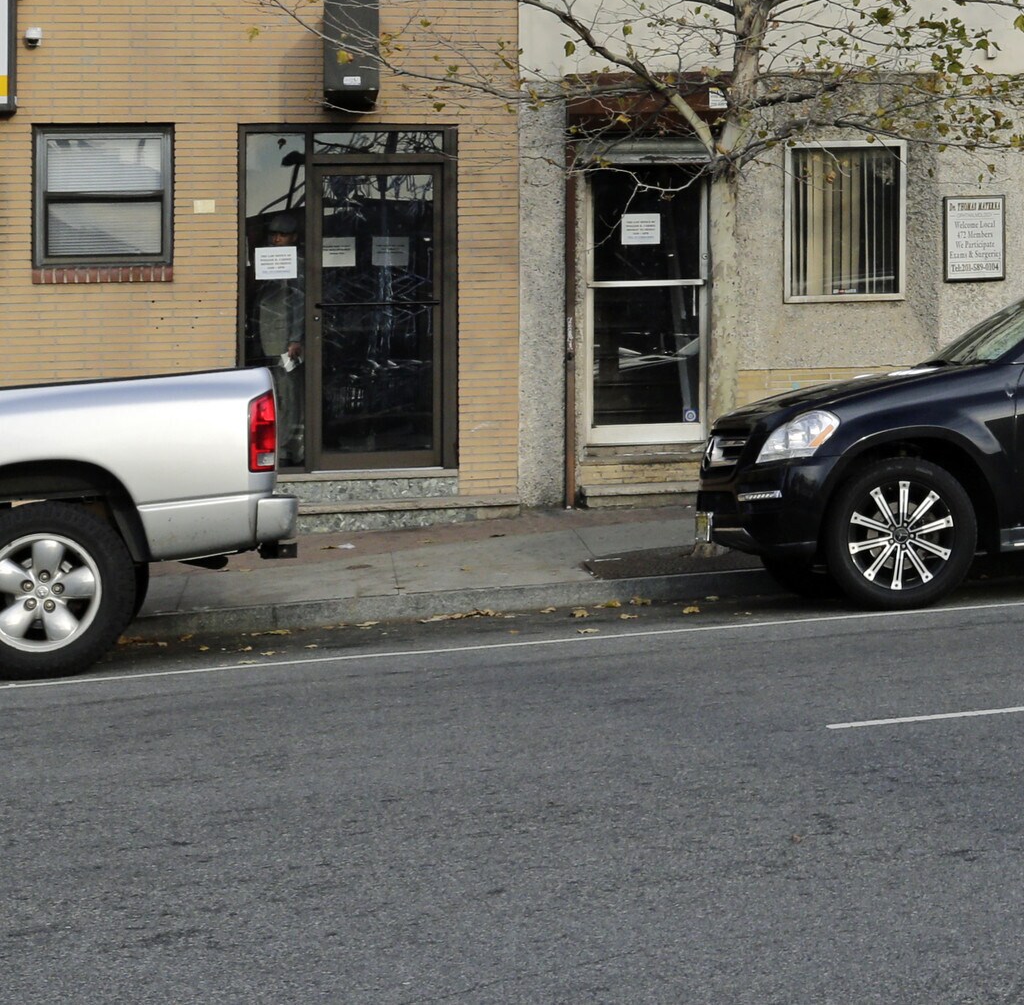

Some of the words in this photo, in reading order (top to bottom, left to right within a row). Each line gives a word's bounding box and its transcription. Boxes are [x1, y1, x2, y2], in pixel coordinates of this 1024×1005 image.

[957, 202, 977, 211] THOMAS
[978, 201, 1001, 211] MATERNA
[954, 220, 979, 229] Welcome
[980, 220, 996, 228] Local
[957, 231, 967, 239] 472
[968, 230, 993, 238] Members
[965, 240, 995, 250] Participate
[949, 251, 968, 259] Exams
[969, 250, 974, 258] &
